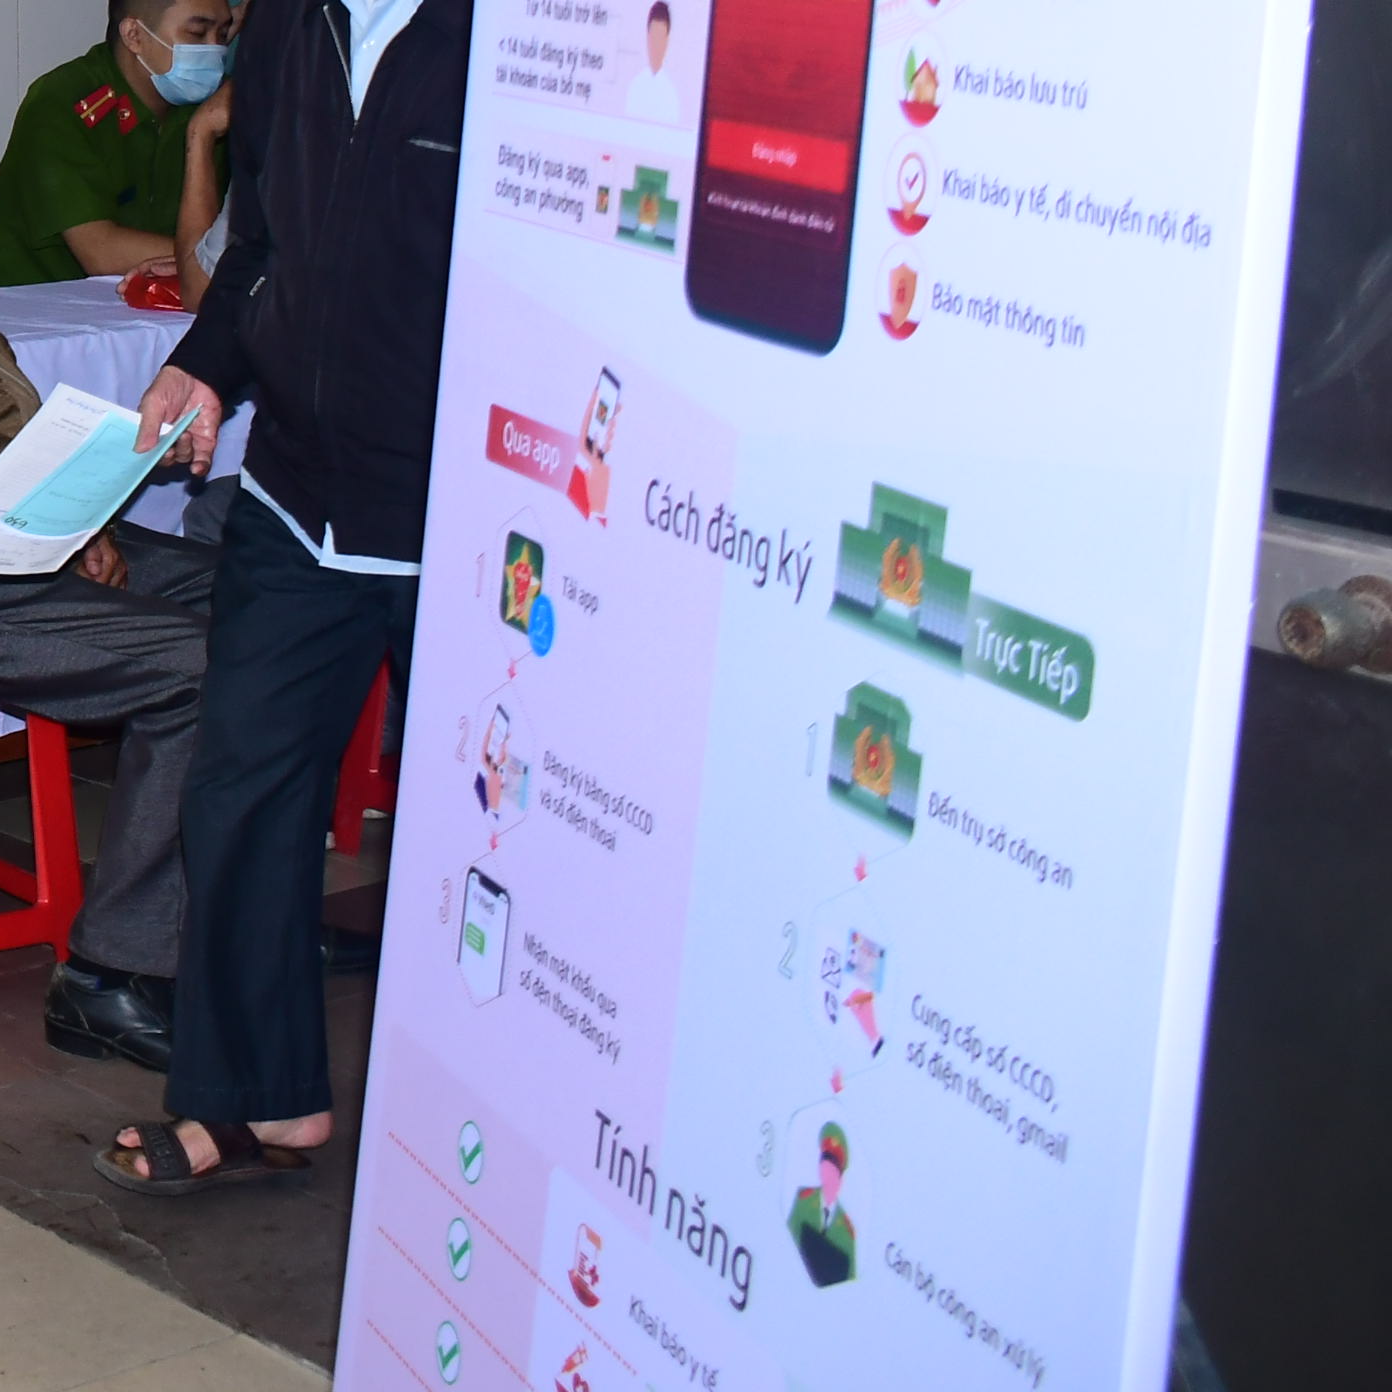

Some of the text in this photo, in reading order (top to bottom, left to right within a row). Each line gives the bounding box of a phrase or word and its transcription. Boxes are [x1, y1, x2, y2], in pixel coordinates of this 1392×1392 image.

[502, 421, 560, 475] Qua app
[645, 478, 813, 605] Cách đăng ký
[976, 617, 1080, 705] Trực Tiếp
[595, 1109, 753, 1312] Tính năng
